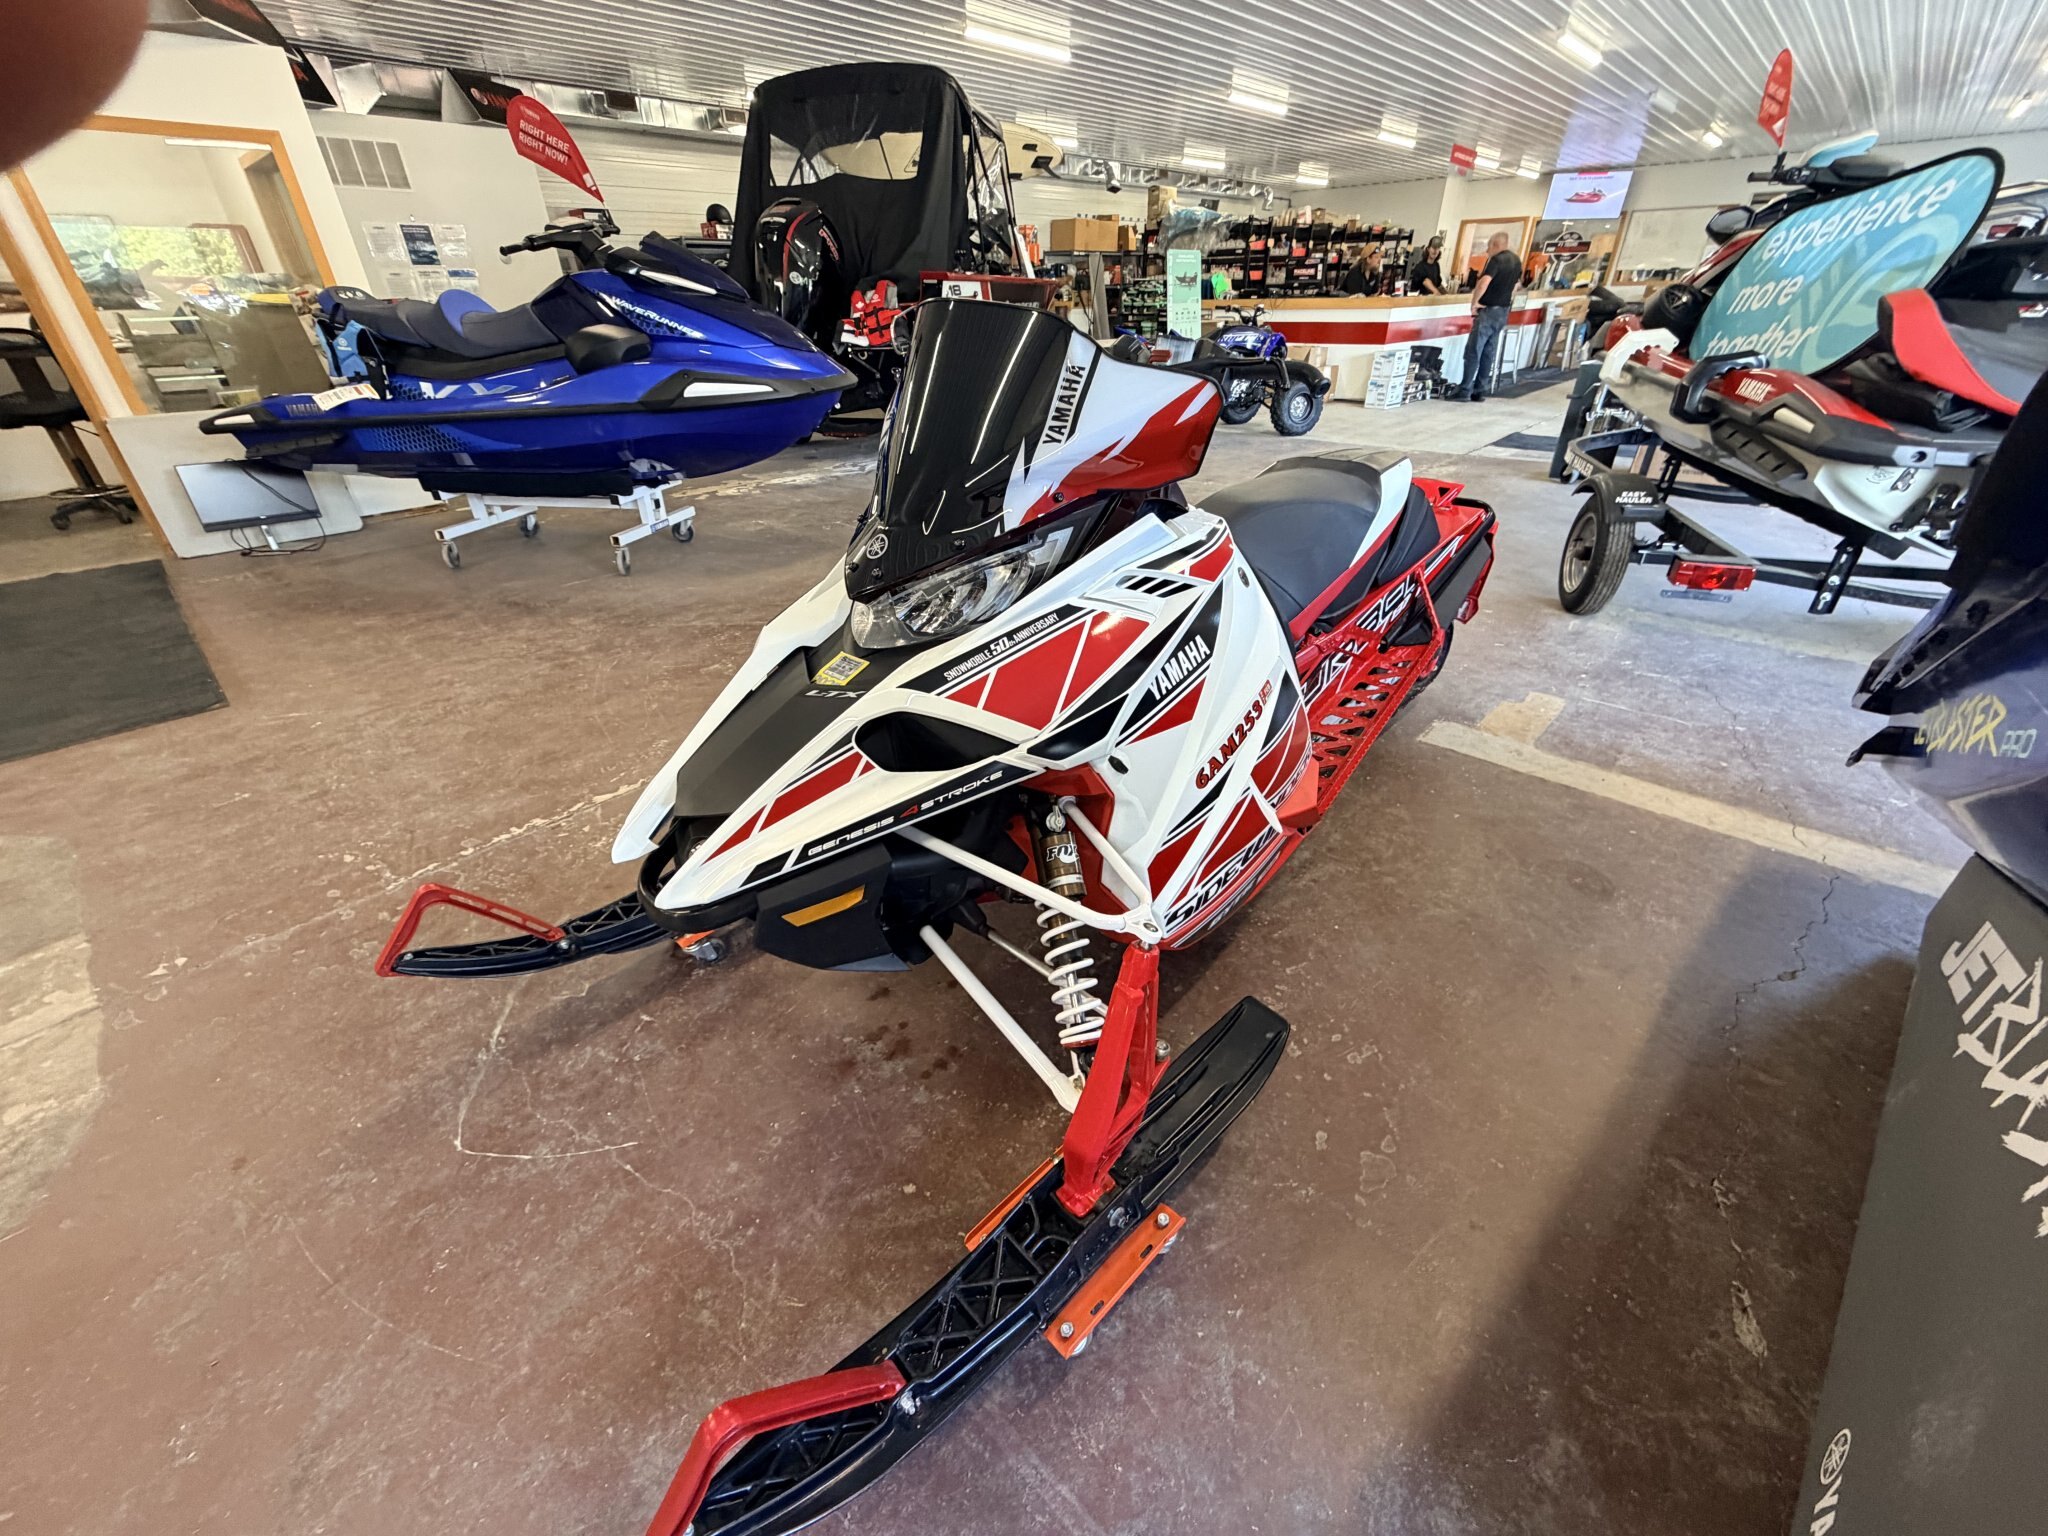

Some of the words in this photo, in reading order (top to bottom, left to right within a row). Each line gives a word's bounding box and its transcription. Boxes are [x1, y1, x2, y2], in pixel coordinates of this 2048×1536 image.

[518, 131, 545, 152] RIGHT
[545, 147, 569, 165] NOW!
[520, 119, 545, 139] RIGHT
[546, 134, 570, 154] HERE
[1762, 178, 1957, 268] experience
[1727, 273, 1804, 315] more
[1703, 314, 1819, 360] together
[1042, 364, 1087, 445] YAMAHA
[1735, 377, 1774, 403] YAMAHA
[1614, 496, 1654, 504] HAULER
[1620, 490, 1648, 498] EASY
[943, 649, 993, 682] SNOWMOBILE
[1013, 612, 1060, 643] ANNIVERSARY
[1148, 634, 1211, 701] YAMAHA
[1195, 699, 1263, 790] 6AM253
[2000, 728, 2038, 759] PRO
[807, 815, 895, 857] GENESIS
[1046, 843, 1080, 864] FOX
